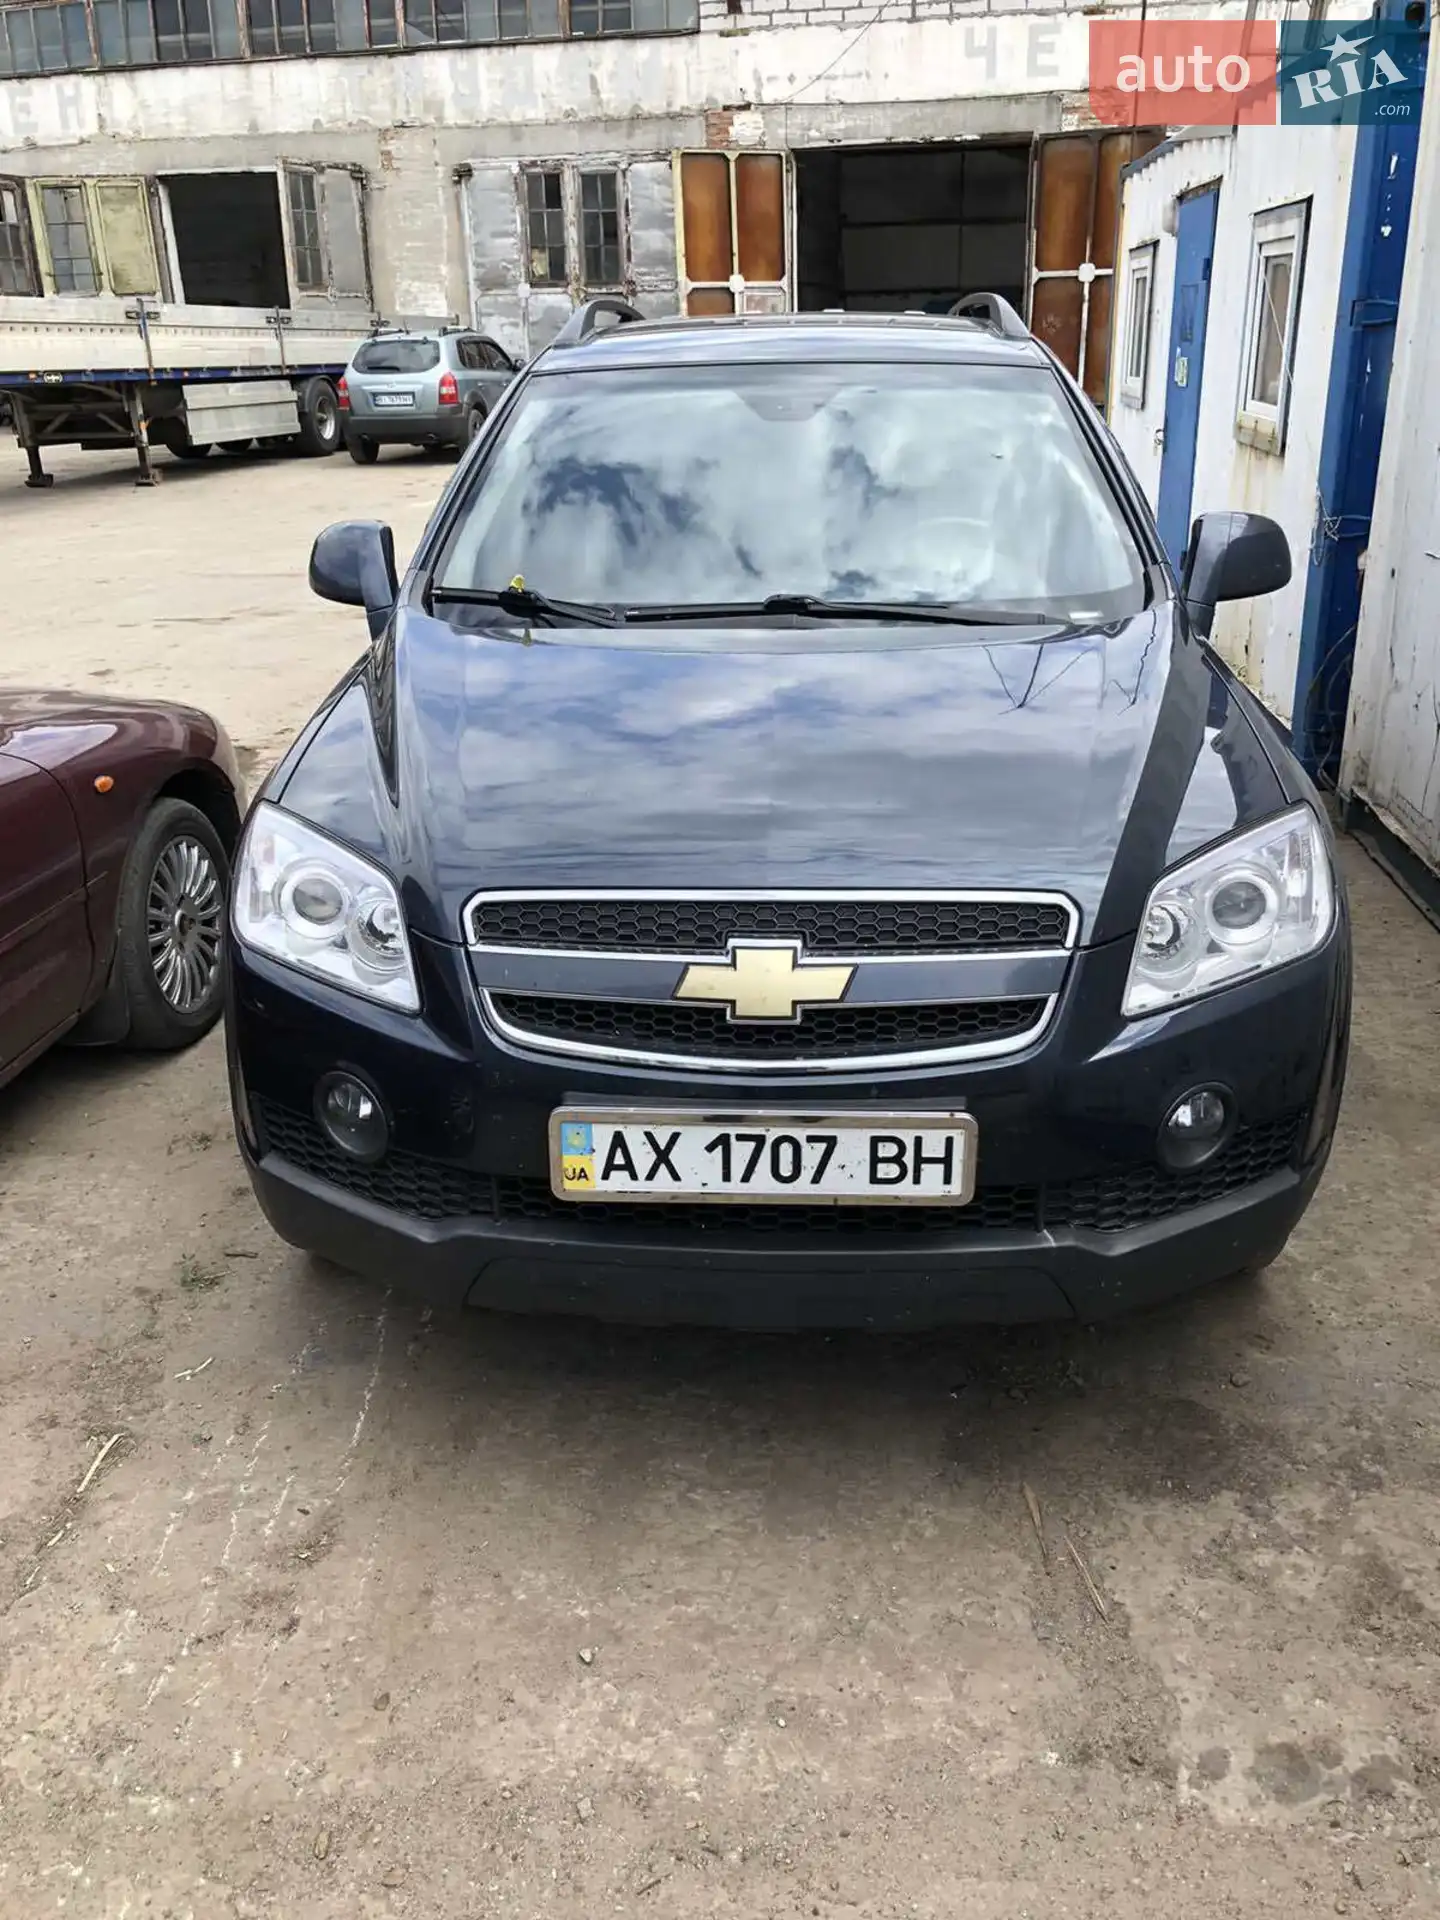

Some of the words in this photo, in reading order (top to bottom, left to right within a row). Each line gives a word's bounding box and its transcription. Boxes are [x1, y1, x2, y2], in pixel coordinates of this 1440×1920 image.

[562, 1166, 589, 1182] UA
[600, 1130, 683, 1183] AX
[703, 1132, 839, 1185] 1707
[868, 1135, 954, 1186] BH
